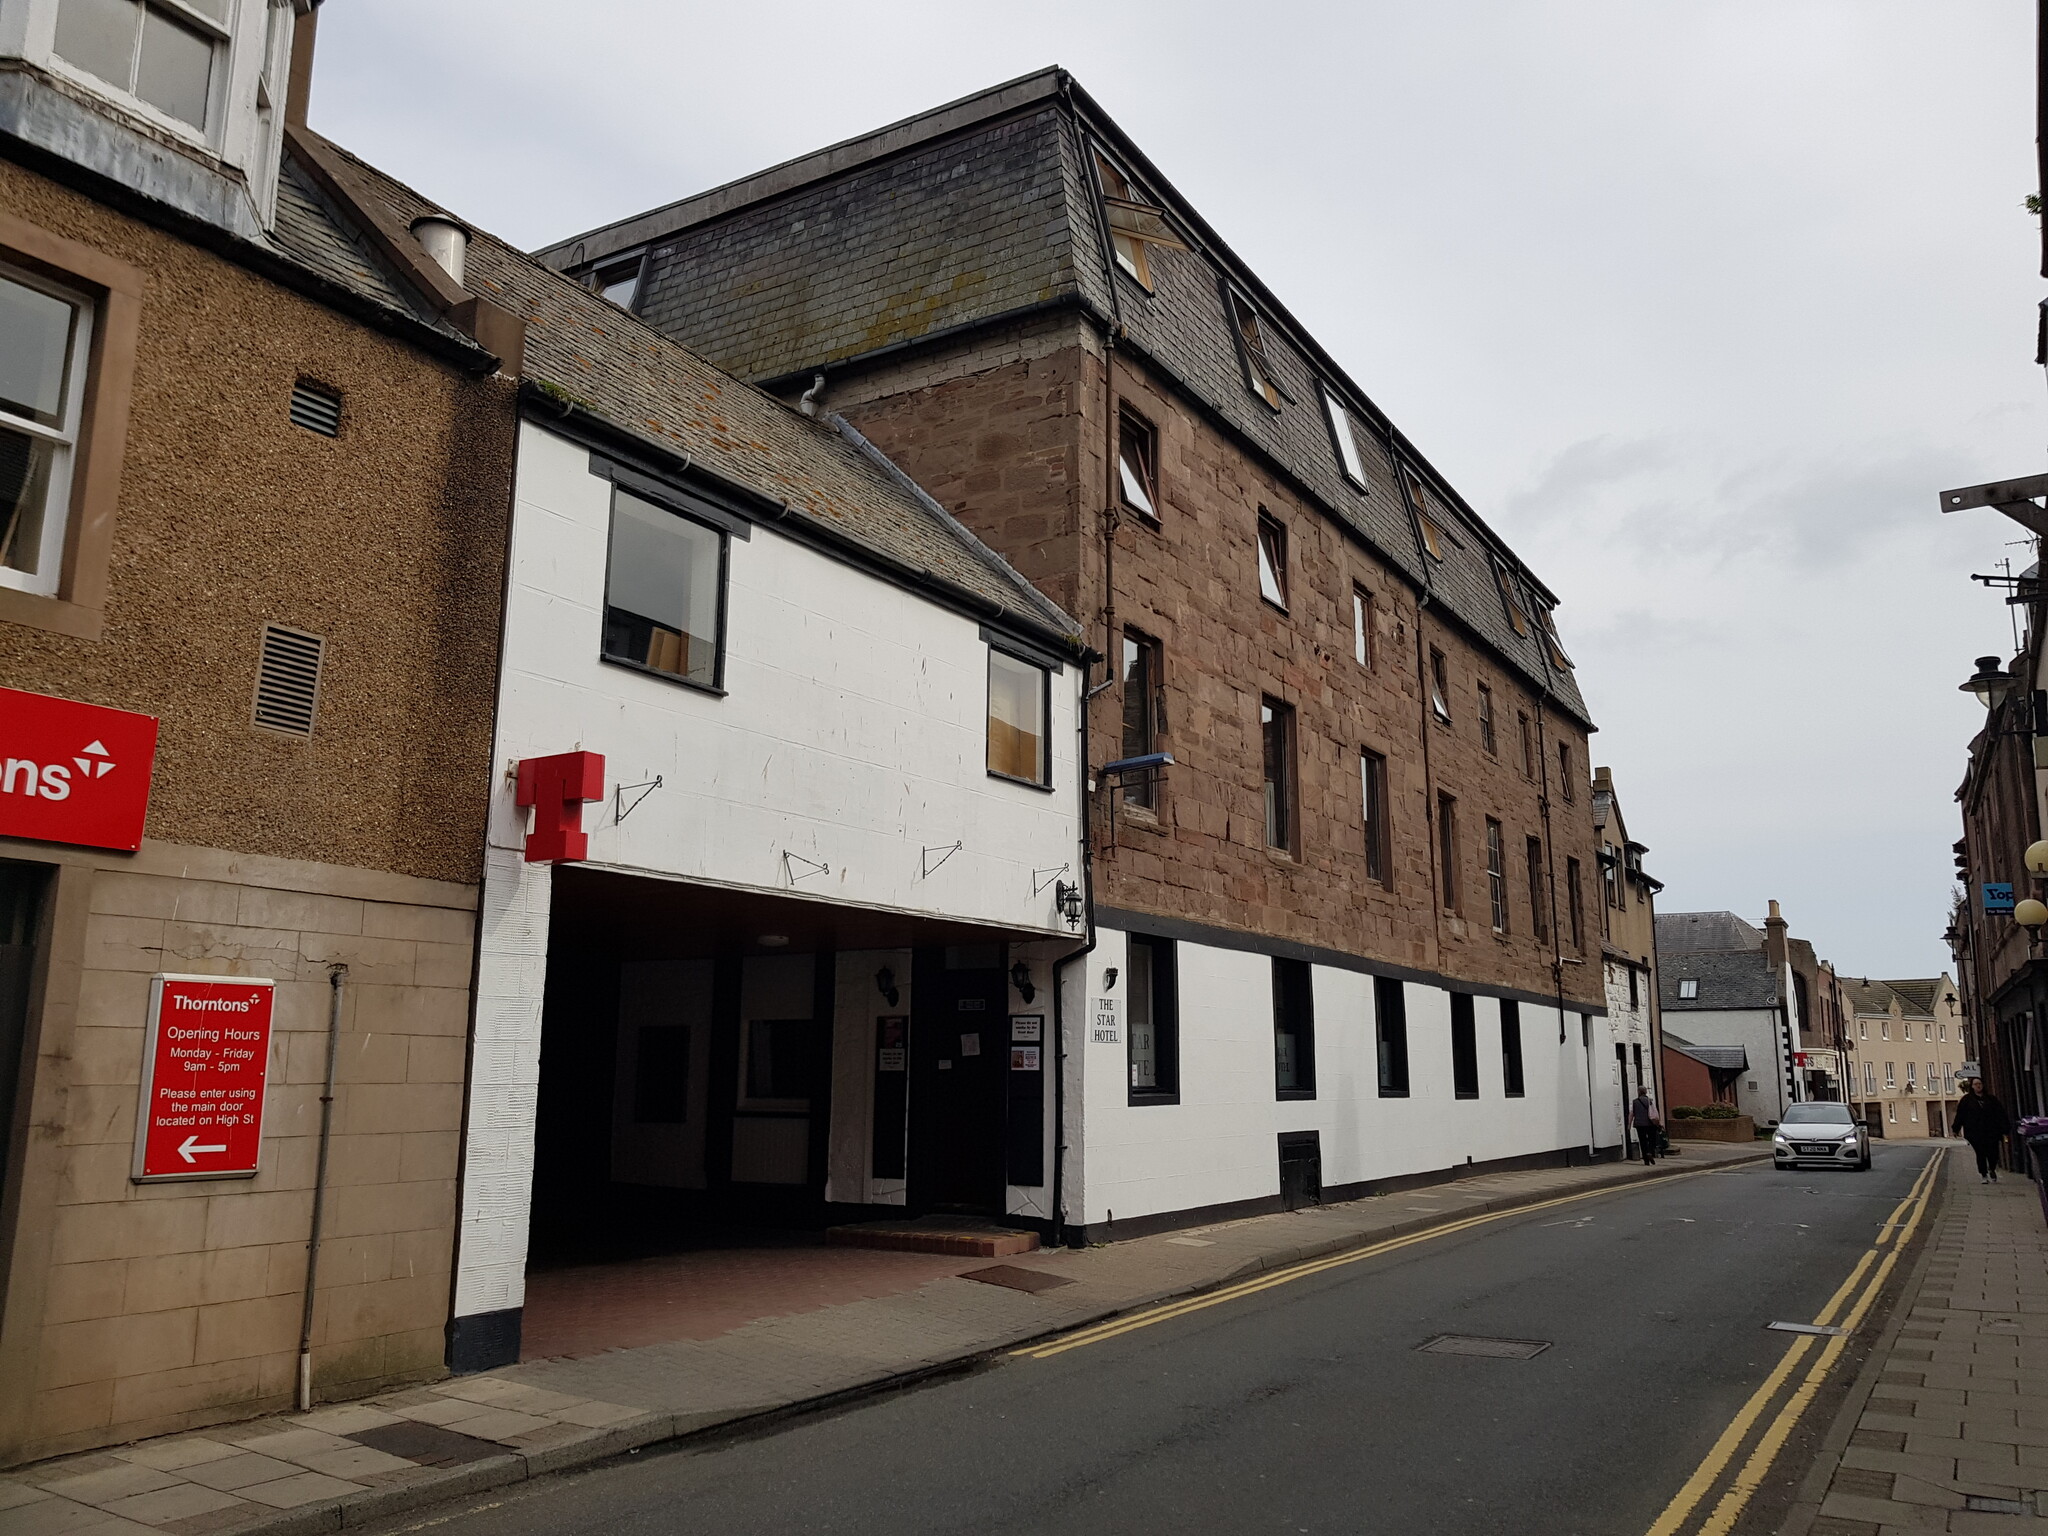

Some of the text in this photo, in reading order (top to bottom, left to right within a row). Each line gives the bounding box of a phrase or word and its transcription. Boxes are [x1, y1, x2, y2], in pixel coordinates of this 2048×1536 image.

[0, 757, 72, 801] ns
[173, 994, 250, 1013] Thorntons
[1098, 998, 1114, 1011] THE
[1096, 1013, 1116, 1026] STAR
[167, 1026, 260, 1042] Opening Hours
[1094, 1029, 1119, 1042] HOTEL
[170, 1047, 212, 1061] Monday
[223, 1048, 255, 1061] Friday
[183, 1061, 206, 1072] 9am
[217, 1061, 240, 1074] 5pm
[160, 1088, 256, 1100] Please enter using
[171, 1101, 244, 1112] the main door
[156, 1114, 254, 1127] located on High St
